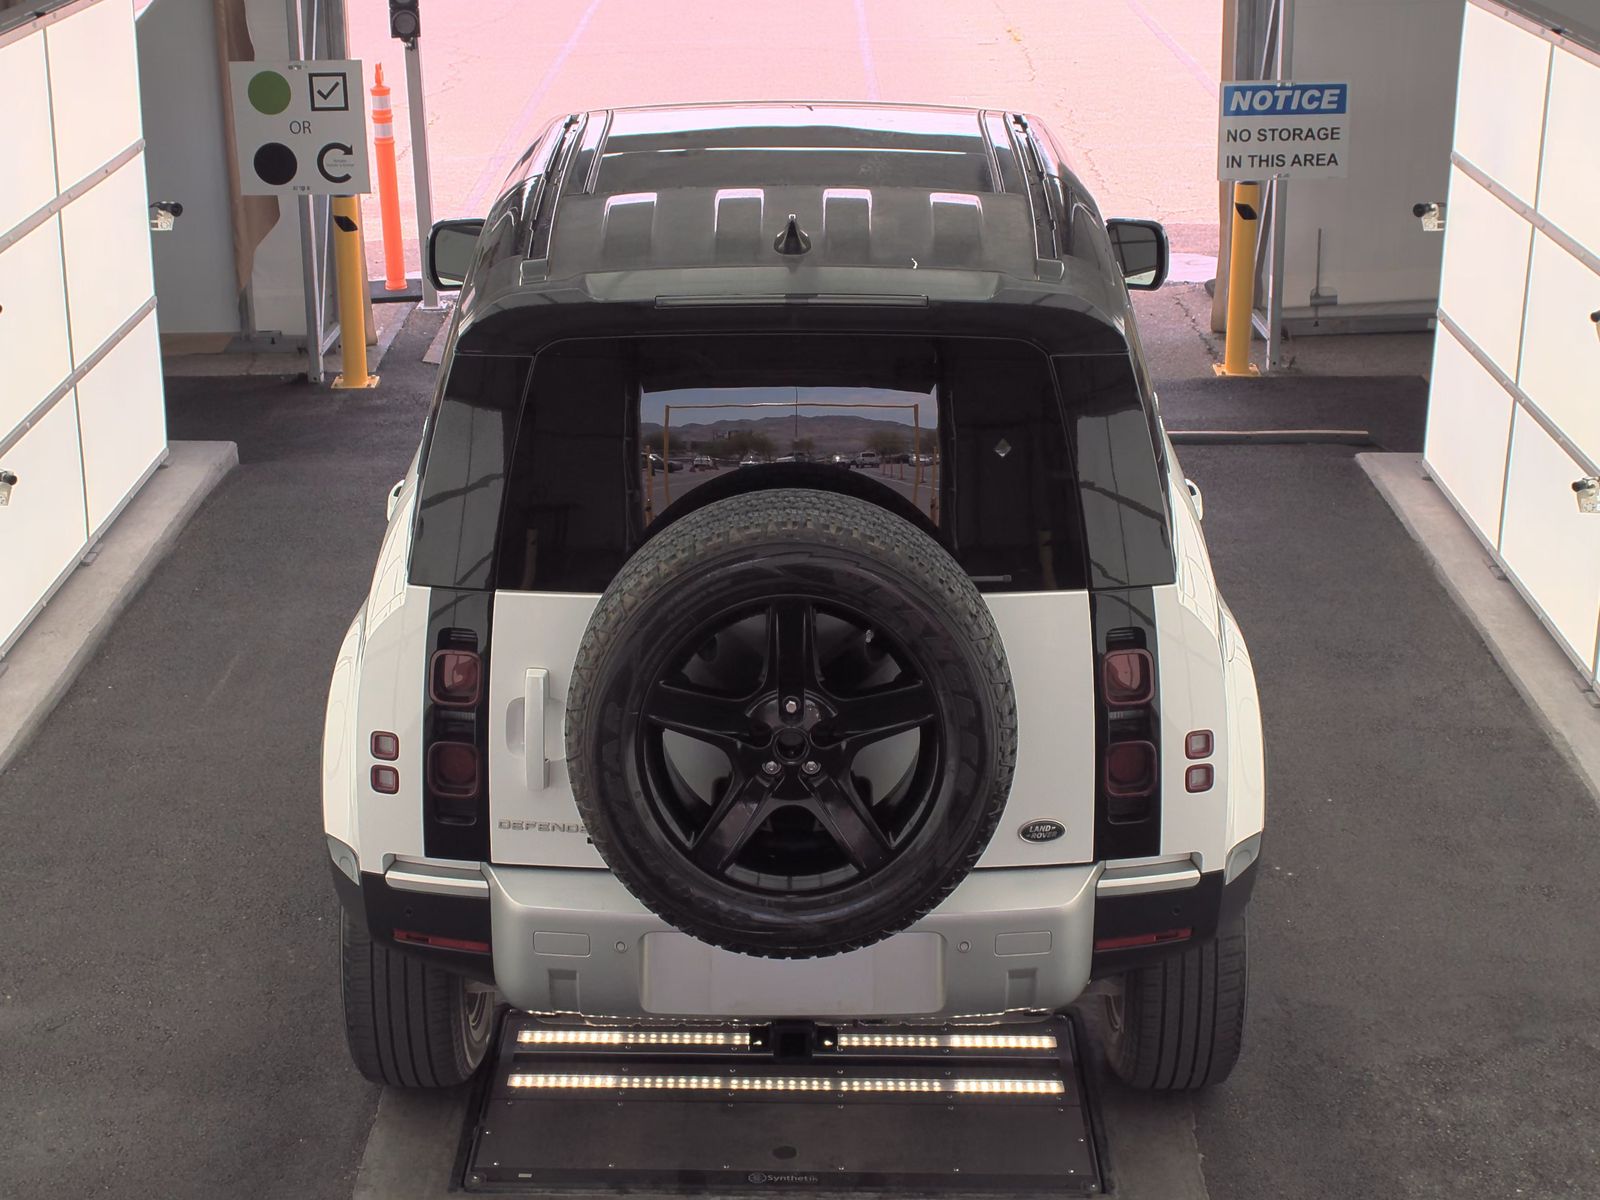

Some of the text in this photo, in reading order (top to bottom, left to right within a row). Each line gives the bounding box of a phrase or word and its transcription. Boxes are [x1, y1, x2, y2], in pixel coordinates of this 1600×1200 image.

[1230, 88, 1341, 111] NOTICE
[289, 120, 312, 135] OR
[1226, 127, 1341, 142] NO STORAGE
[1226, 153, 1339, 168] IN THIS AREA
